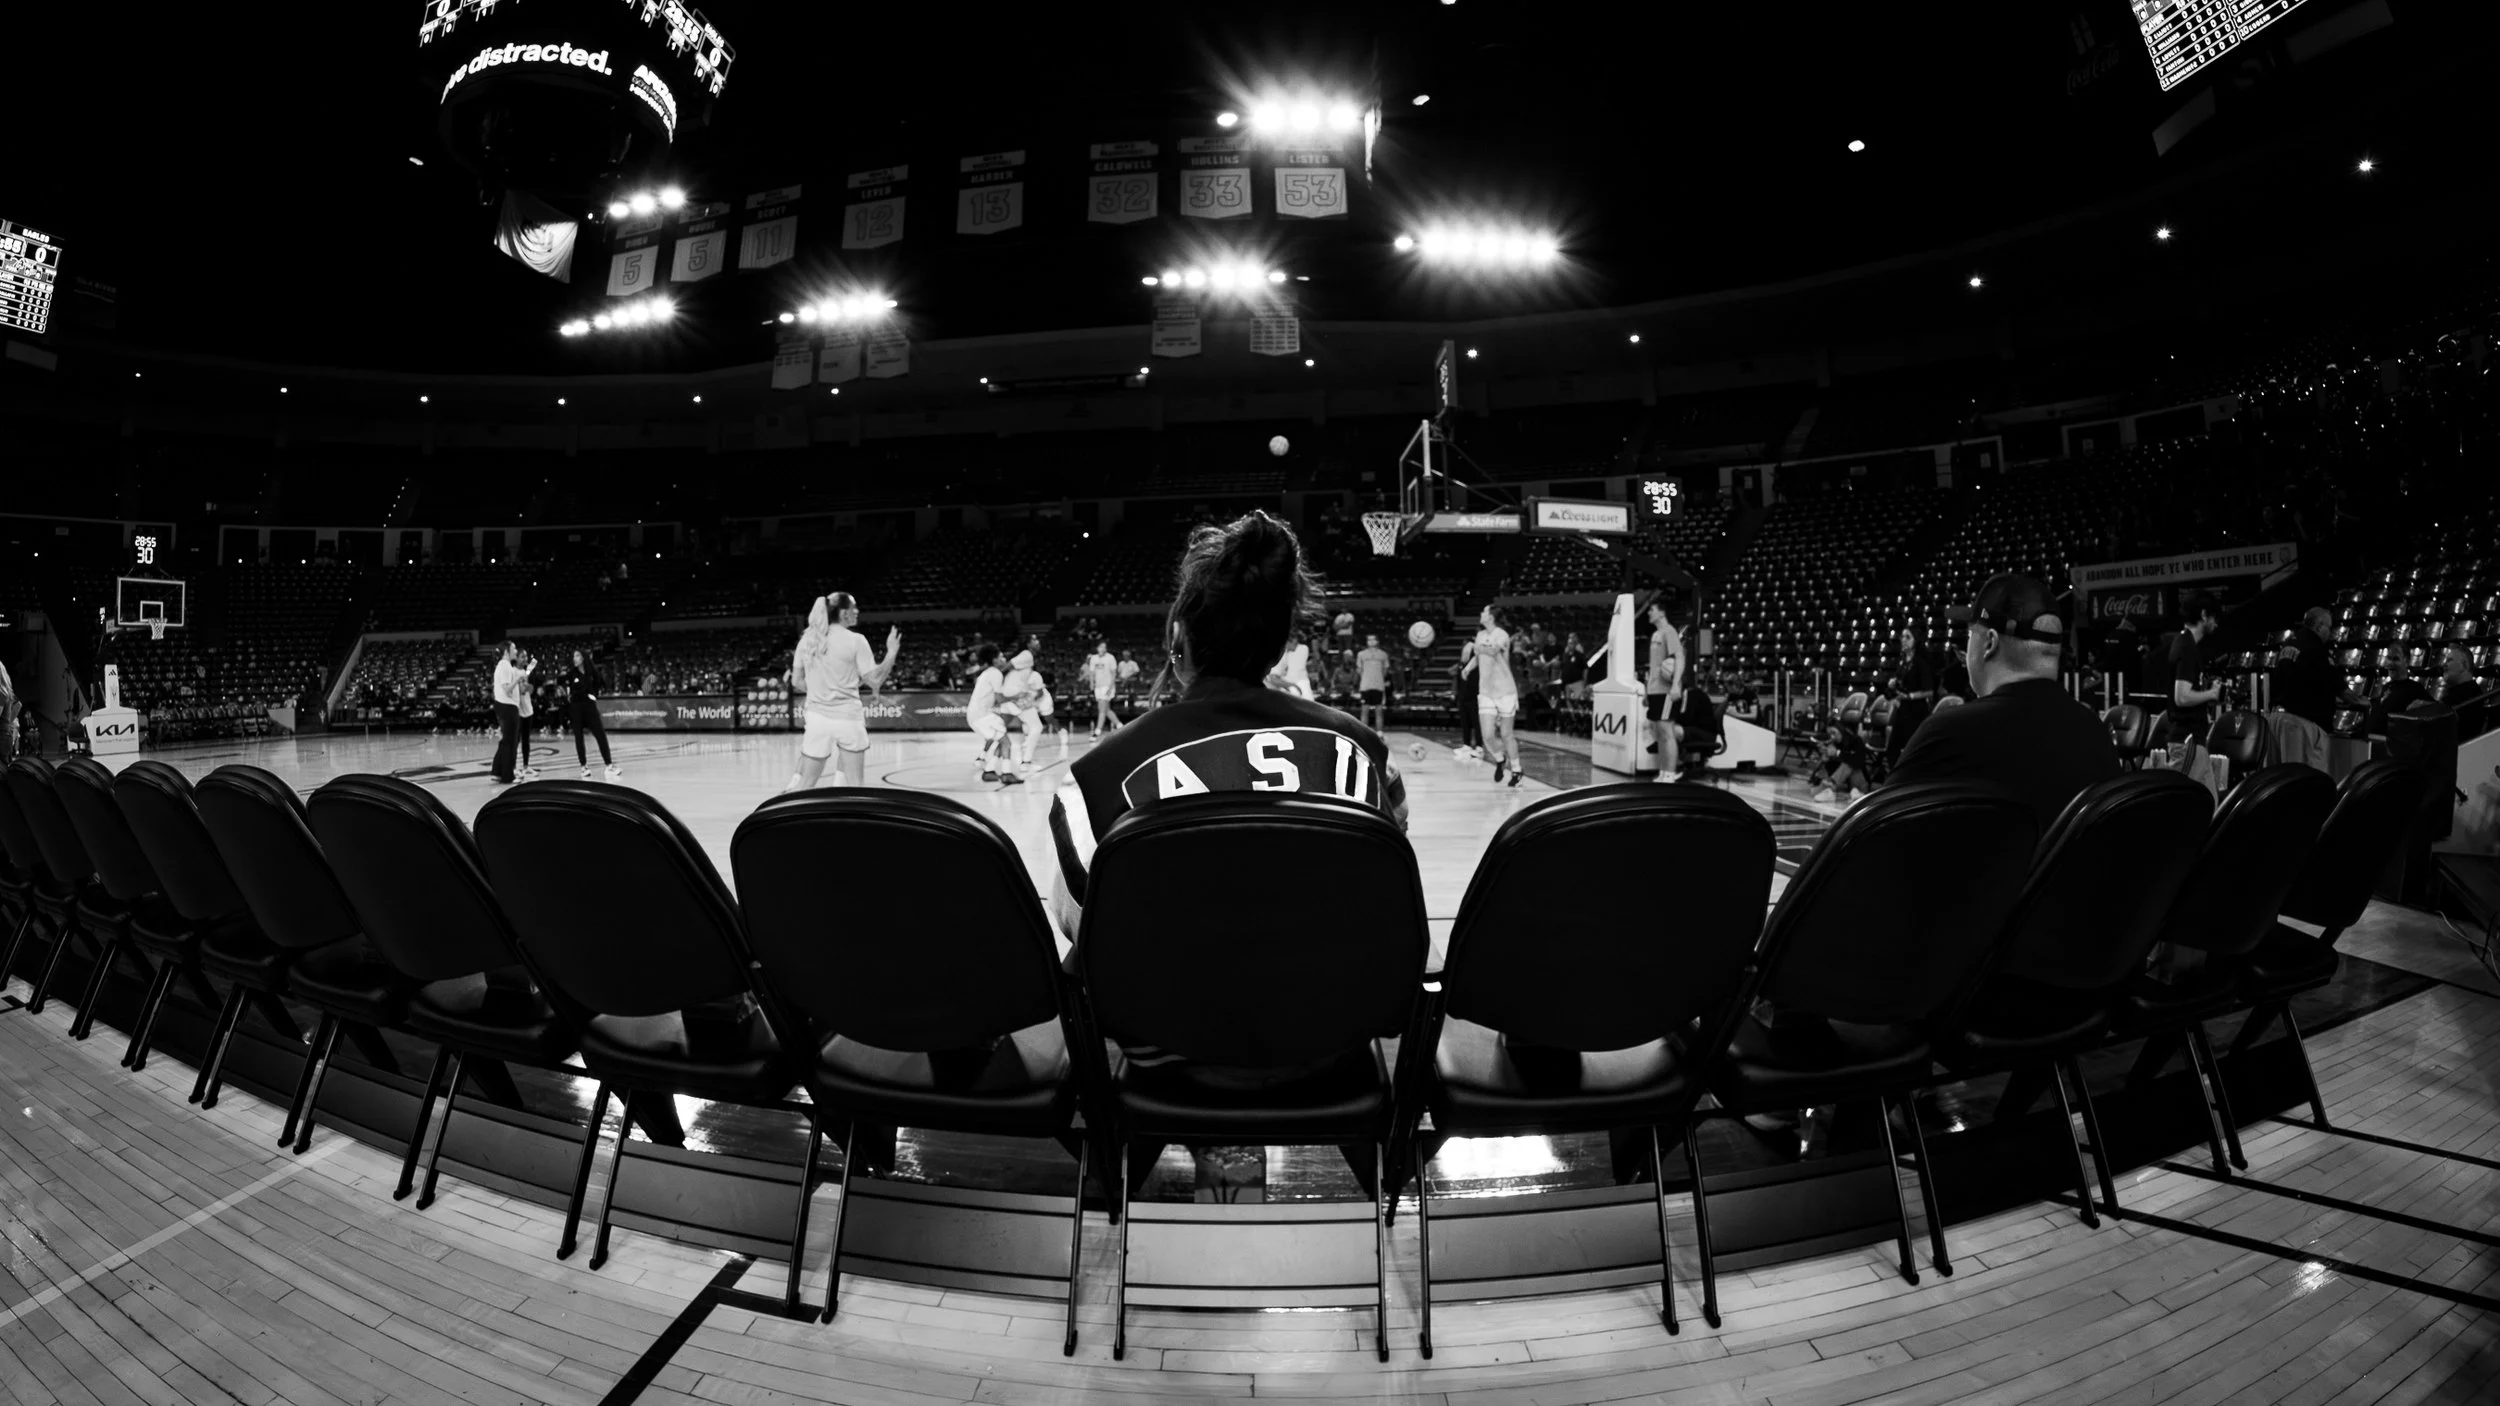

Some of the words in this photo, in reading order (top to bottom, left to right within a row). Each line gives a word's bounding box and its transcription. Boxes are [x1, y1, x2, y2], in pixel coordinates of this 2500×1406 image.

[468, 42, 612, 76] distracted.
[1094, 160, 1153, 172] CALDWELL
[1190, 155, 1240, 167] HOLLINS
[1289, 154, 1330, 165] LISTER
[1096, 181, 1150, 214] 32
[1189, 174, 1242, 208] 33
[1285, 174, 1338, 207] 53
[970, 188, 1011, 226] 13
[854, 204, 894, 241] 12
[756, 226, 782, 260] 11
[35, 247, 46, 263] 0
[688, 240, 709, 272] 5
[622, 254, 643, 286] 5
[1643, 481, 1677, 497] 28:55
[1652, 496, 1671, 515] 30
[135, 536, 157, 548] 28:55
[137, 546, 154, 565] 30
[2125, 565, 2140, 578] ALL
[2142, 563, 2165, 576] HOPE
[2169, 561, 2181, 574] YE
[2183, 558, 2205, 573] WHO
[2207, 555, 2240, 570] ENTER
[2243, 552, 2274, 568] HERE
[677, 706, 696, 719] The
[96, 724, 134, 736] KIA
[1594, 713, 1627, 736] KIA
